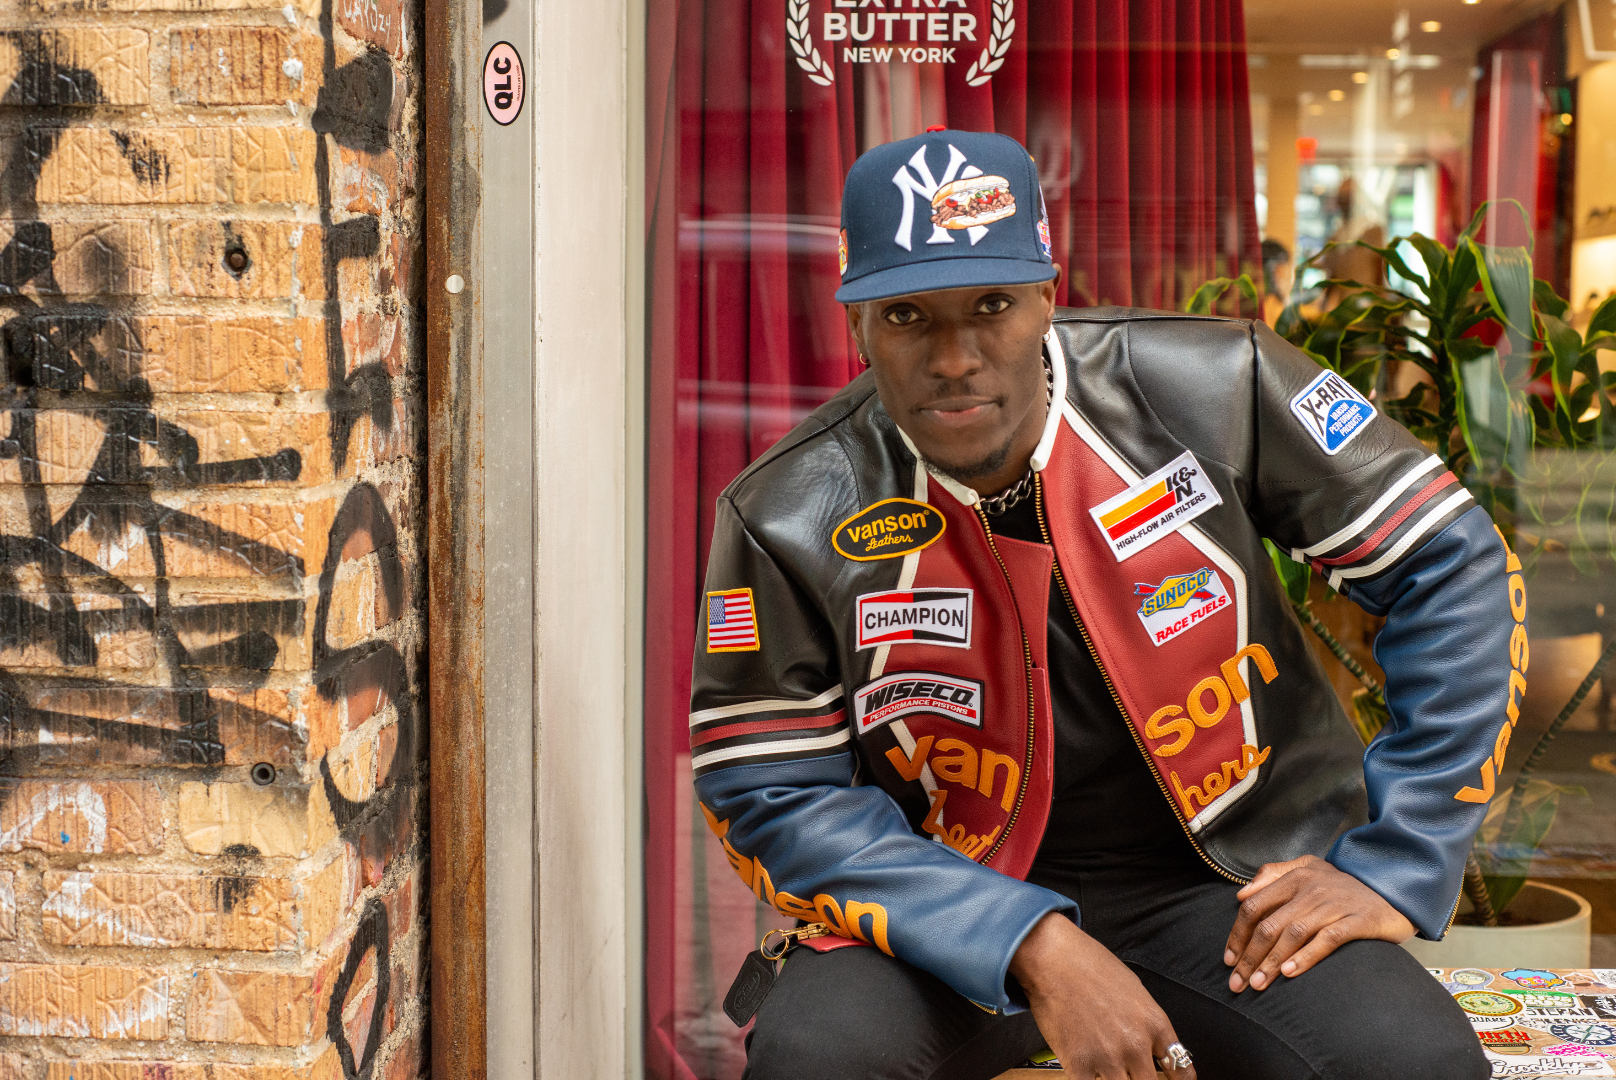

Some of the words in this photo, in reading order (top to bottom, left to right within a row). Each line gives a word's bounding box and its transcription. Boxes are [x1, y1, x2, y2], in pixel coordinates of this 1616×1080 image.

[823, 12, 977, 41] BUTTER
[843, 47, 893, 63] NEW
[898, 47, 956, 63] YORK
[494, 57, 513, 109] QLC
[1300, 375, 1355, 437] X-RAY
[1328, 403, 1361, 435] PERFORMANCE
[1339, 413, 1363, 437] PRODUCTS
[1115, 520, 1159, 551] HIGH-FLOW
[1160, 512, 1175, 526] AIR
[1174, 492, 1207, 516] FILTERS
[865, 532, 914, 552] Leathers
[1145, 570, 1206, 614] SUNOCO
[864, 607, 964, 630] CHAMPION
[1155, 617, 1189, 643] RACE
[1189, 595, 1227, 623] FUELS
[864, 681, 975, 715] WISECO
[869, 699, 930, 723] PERFORMANCE
[931, 700, 968, 716] PISTONS
[1144, 643, 1279, 758] son
[885, 735, 1020, 813] van
[1170, 744, 1272, 819] hers
